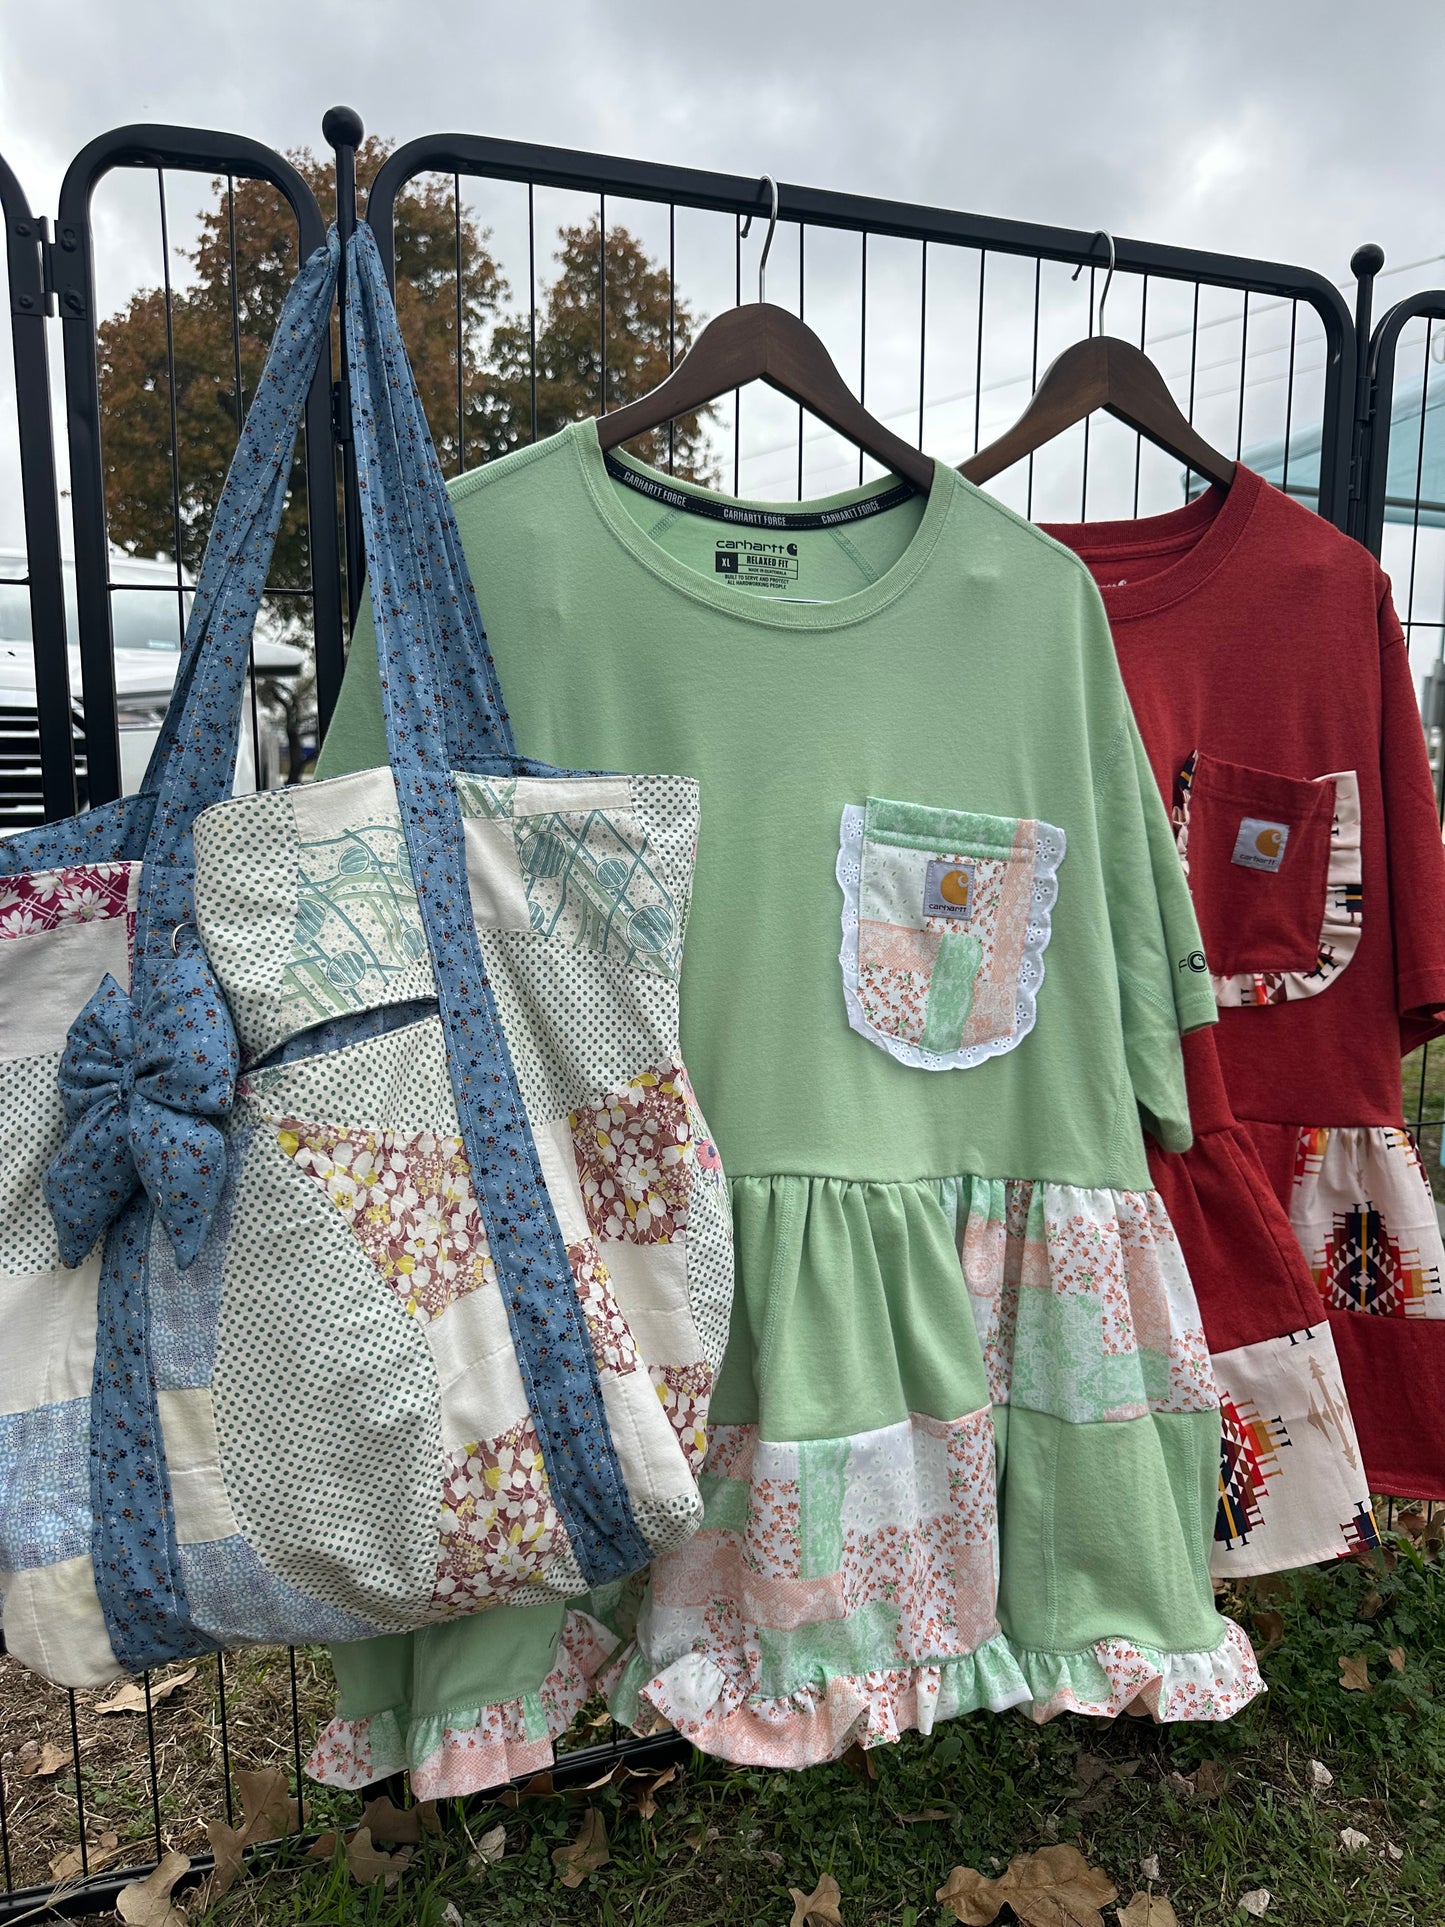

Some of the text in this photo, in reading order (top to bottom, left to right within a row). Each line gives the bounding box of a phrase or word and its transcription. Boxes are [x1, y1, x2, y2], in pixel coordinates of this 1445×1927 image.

[624, 471, 688, 507] CARHARTT FORCE
[723, 508, 786, 526] CARHARTT FORCE
[821, 500, 881, 524] CARHARTT FORCE
[716, 540, 785, 554] carhartt
[721, 558, 731, 567] XL
[746, 555, 789, 568] RELAXED FIT
[736, 580, 769, 588] HARDWORKING
[769, 577, 789, 585] PROTECT
[1240, 854, 1276, 865] carhartt
[929, 903, 967, 913] carhartt
